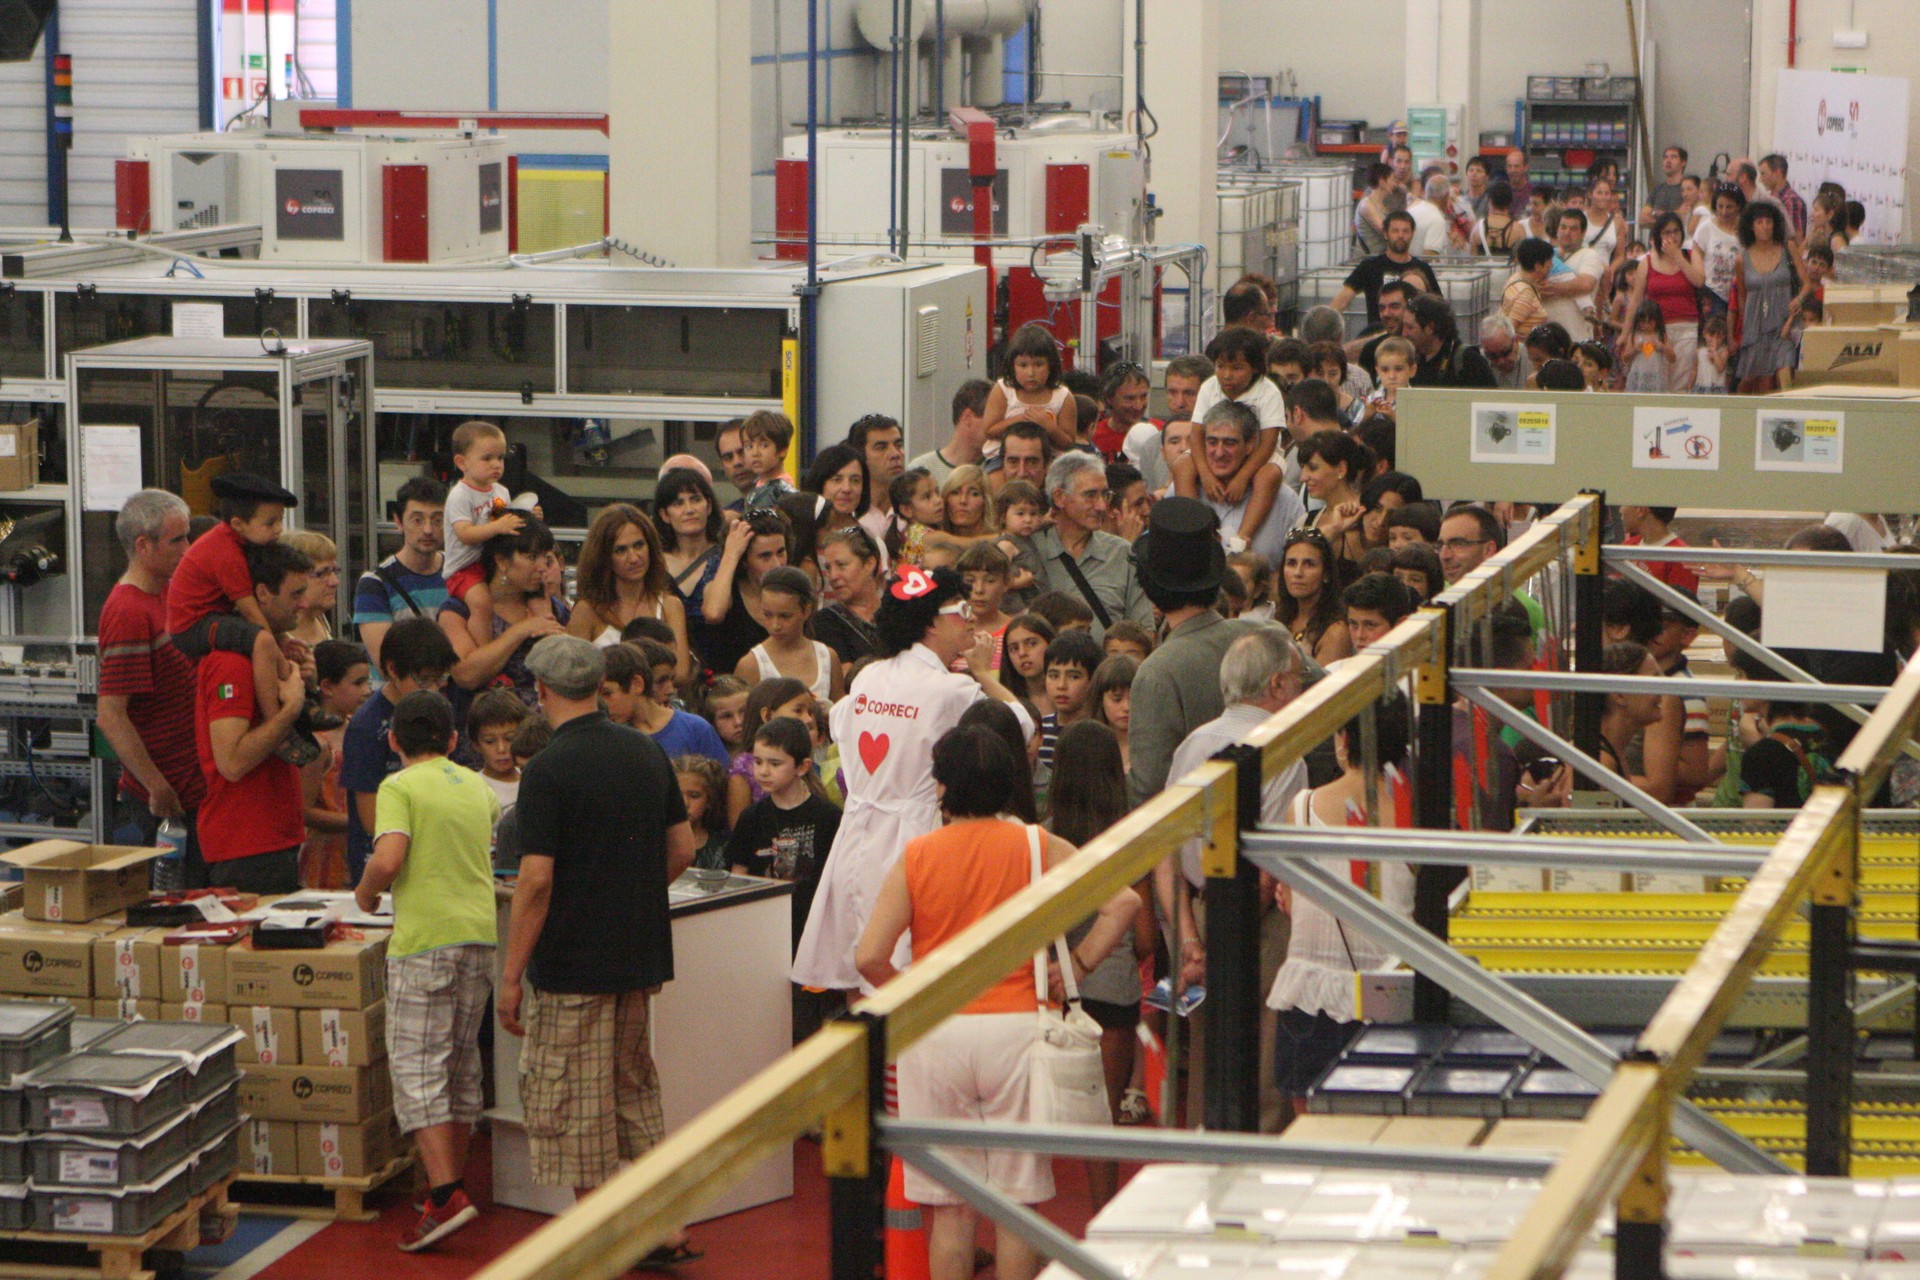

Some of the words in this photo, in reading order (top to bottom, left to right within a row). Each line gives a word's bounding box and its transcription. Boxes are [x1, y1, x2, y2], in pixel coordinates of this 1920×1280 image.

[302, 206, 335, 214] COPRECI
[868, 700, 919, 719] COPRECI
[45, 957, 82, 968] COPRECI
[315, 970, 354, 981] COPRECI
[315, 1084, 352, 1095] COPRECI
